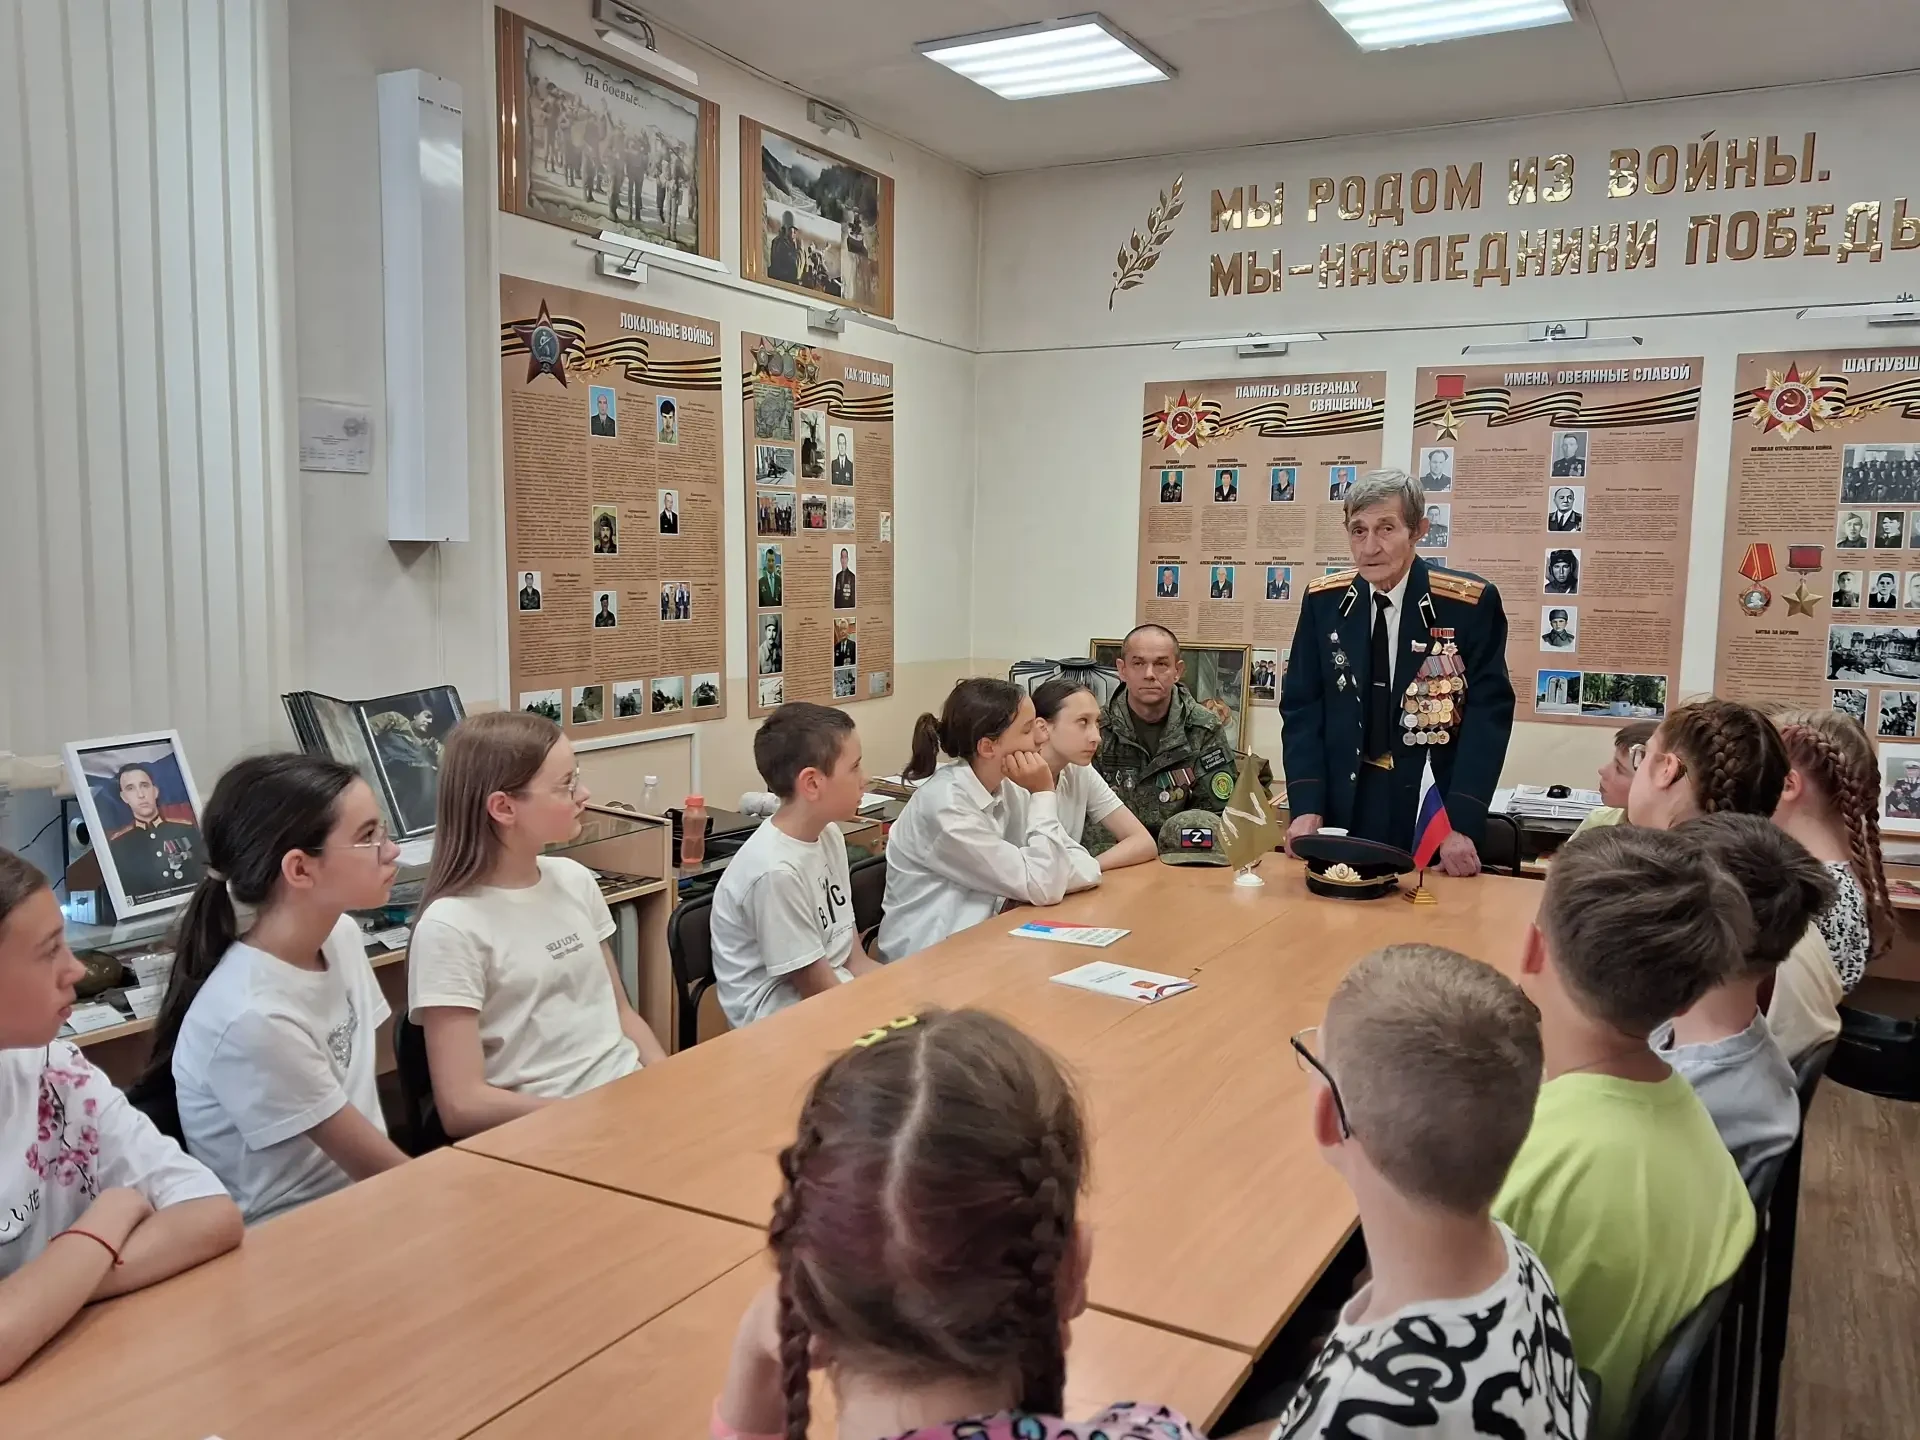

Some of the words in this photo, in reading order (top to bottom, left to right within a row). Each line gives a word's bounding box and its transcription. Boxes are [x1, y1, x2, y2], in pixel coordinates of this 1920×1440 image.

[584, 71, 600, 90] На
[1210, 181, 1284, 232] МЫ
[1307, 161, 1483, 227] РОДОМ
[1508, 153, 1574, 205] ИЗ
[1607, 128, 1830, 199] ВОЙНЫ.
[619, 311, 681, 340] ЛОКАЛЬНЫЕ
[681, 325, 715, 347] ВОЙНЫ
[844, 366, 858, 381] КАК
[859, 369, 871, 384] ЭТО
[871, 372, 890, 388] БЫЛО
[1503, 371, 1554, 387] ИМЕНА,
[1556, 367, 1630, 385] ОВЕЯННЫЕ
[1632, 363, 1691, 382] СЛАВОЙ
[1235, 383, 1281, 399] ПАМЯТЬ
[1283, 383, 1291, 396] О
[1293, 380, 1360, 396] ВЕТЕРАНАХ
[1309, 397, 1374, 413] СВЯЩЕННА
[1191, 831, 1203, 843] Z
